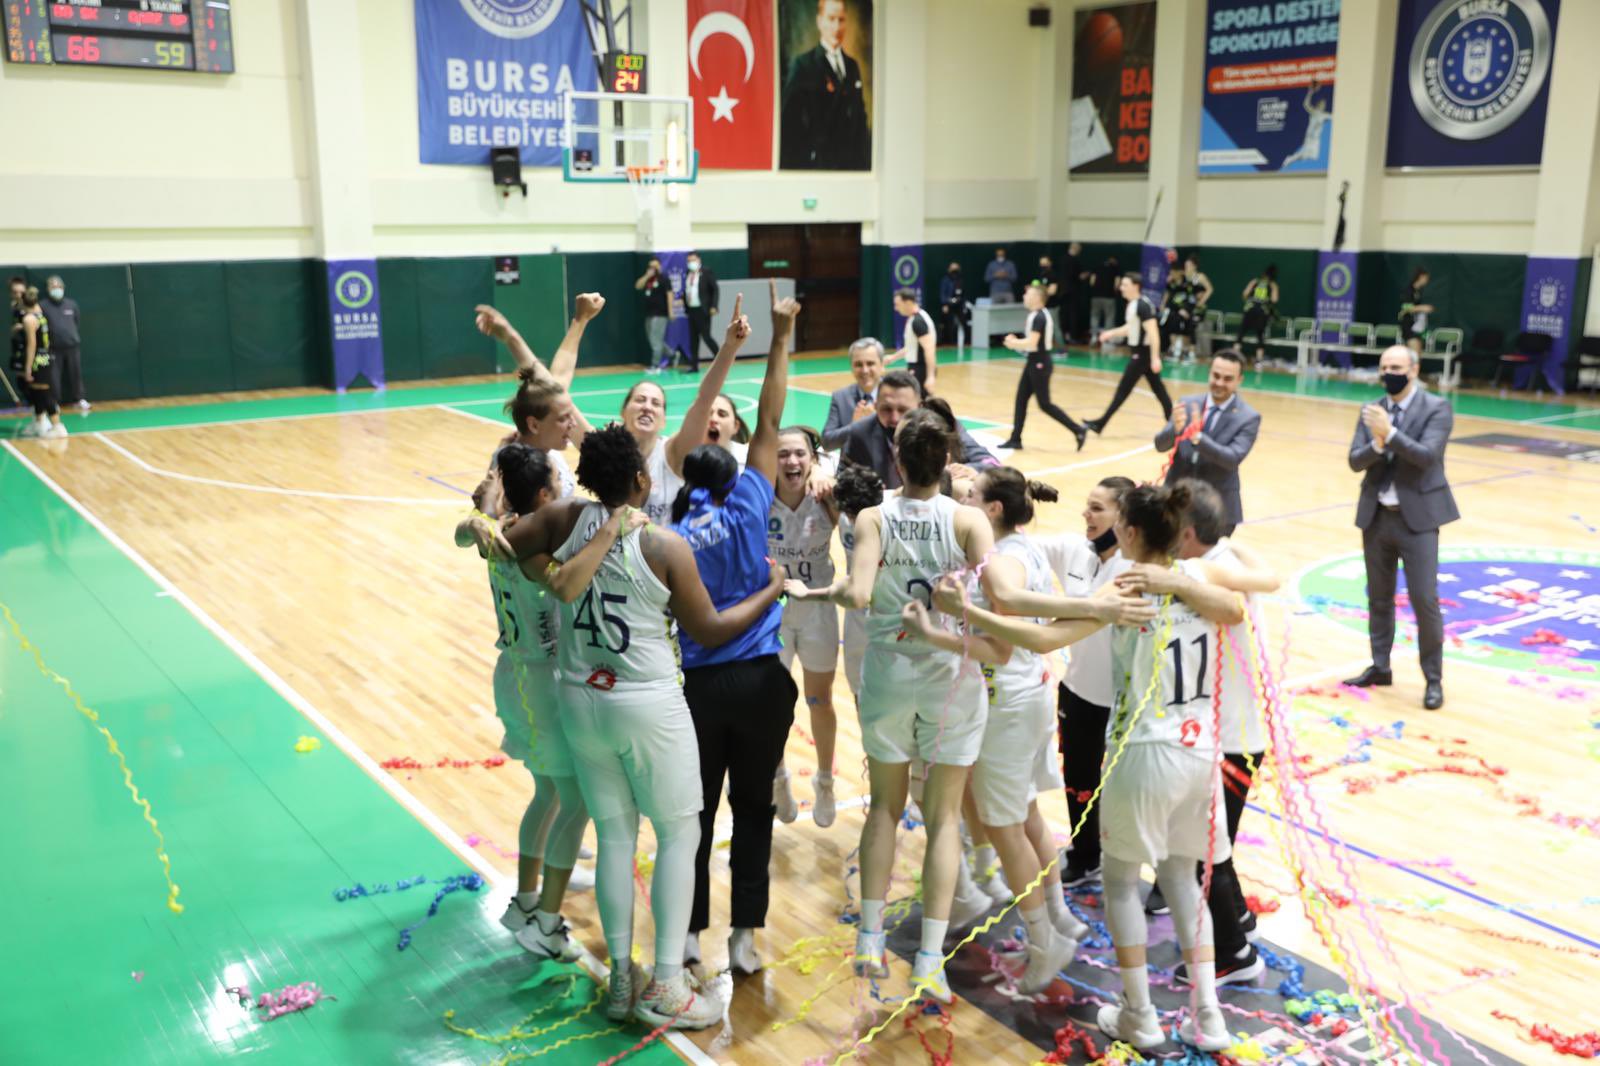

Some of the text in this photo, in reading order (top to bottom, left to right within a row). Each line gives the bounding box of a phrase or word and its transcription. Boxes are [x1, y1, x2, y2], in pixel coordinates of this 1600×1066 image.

[1213, 4, 1272, 31] SPORA
[1458, 0, 1509, 20] BURSA
[67, 36, 185, 65] 66 59
[1209, 28, 1292, 54] SPORCUYA
[447, 58, 575, 93] BURSA
[615, 70, 640, 92] 24
[334, 312, 379, 324] BURSA
[573, 588, 630, 655] 45
[1165, 632, 1212, 706] 11
